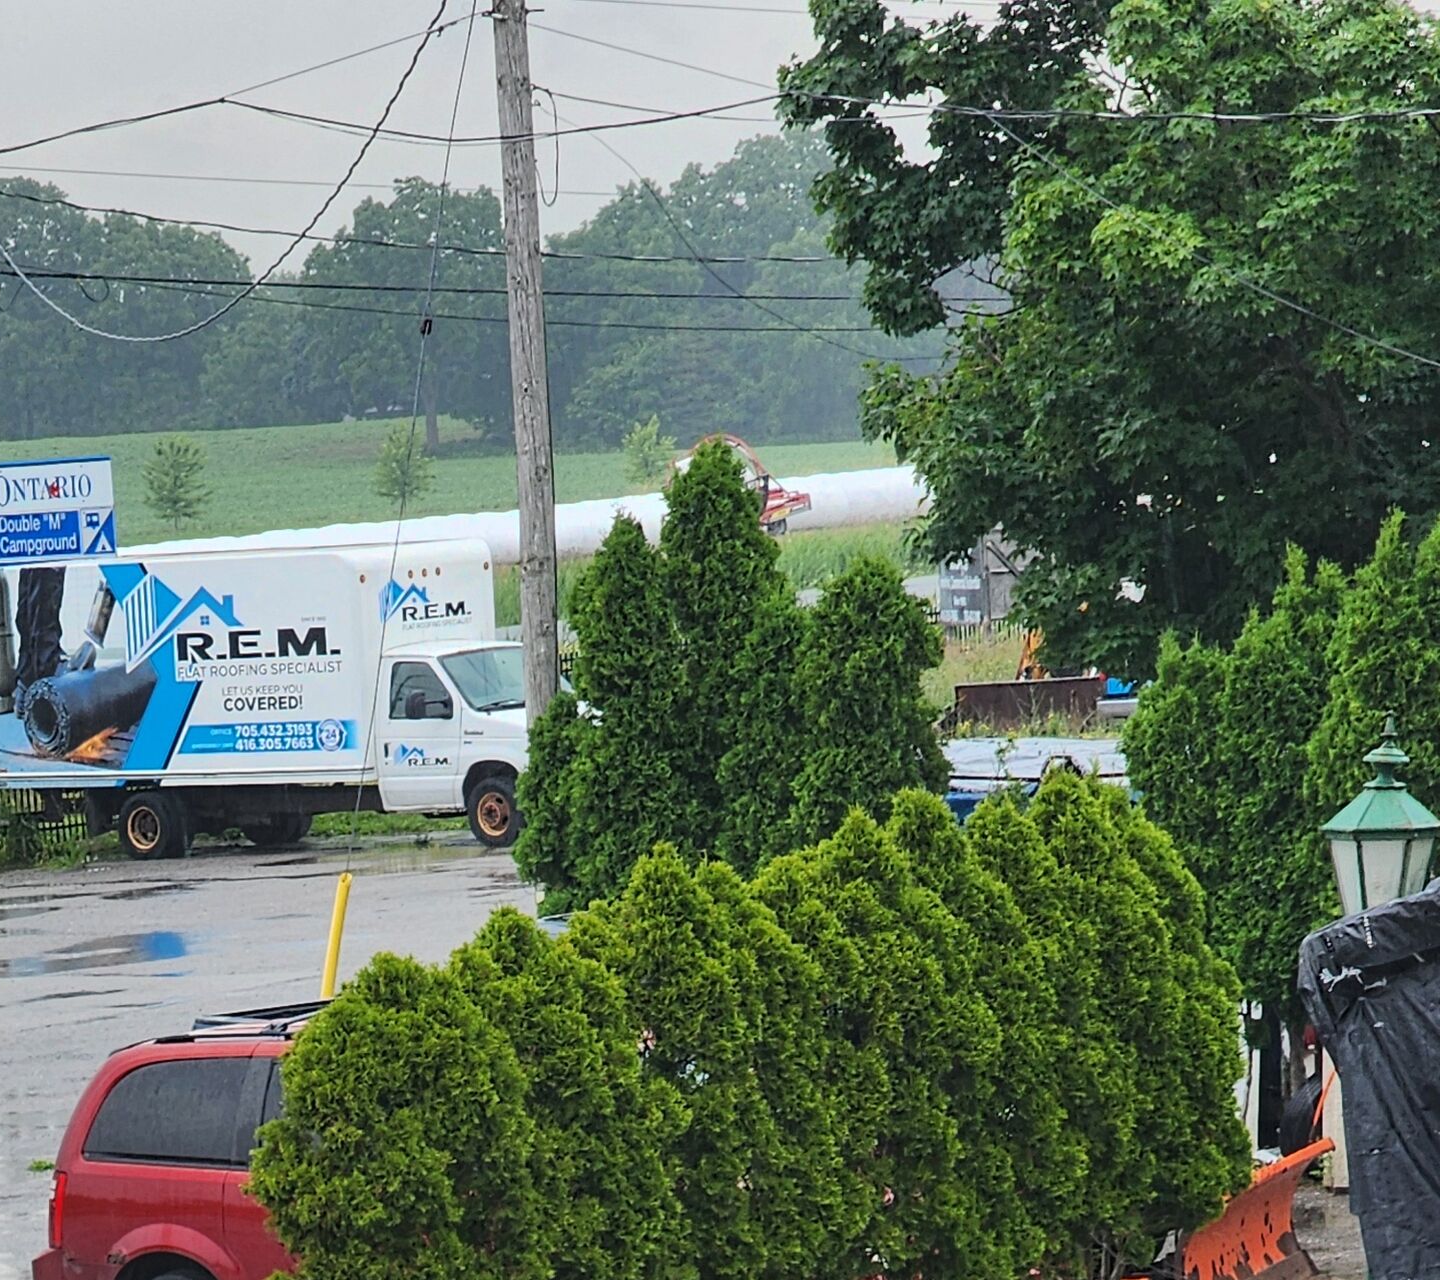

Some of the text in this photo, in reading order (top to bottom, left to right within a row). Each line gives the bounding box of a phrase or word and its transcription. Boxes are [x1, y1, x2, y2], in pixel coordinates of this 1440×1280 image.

[43, 512, 66, 530] "M"
[0, 532, 78, 555] Campground
[401, 601, 472, 622] R.E.M.
[176, 627, 342, 663] R.E.M.
[177, 661, 343, 680] FLAT ROOFING SPECIALIST
[222, 684, 303, 697] LET US KEEP YOU
[223, 695, 303, 712] COVERED!
[234, 724, 313, 738] 705.432.3193
[235, 737, 314, 751] 416.305.7663
